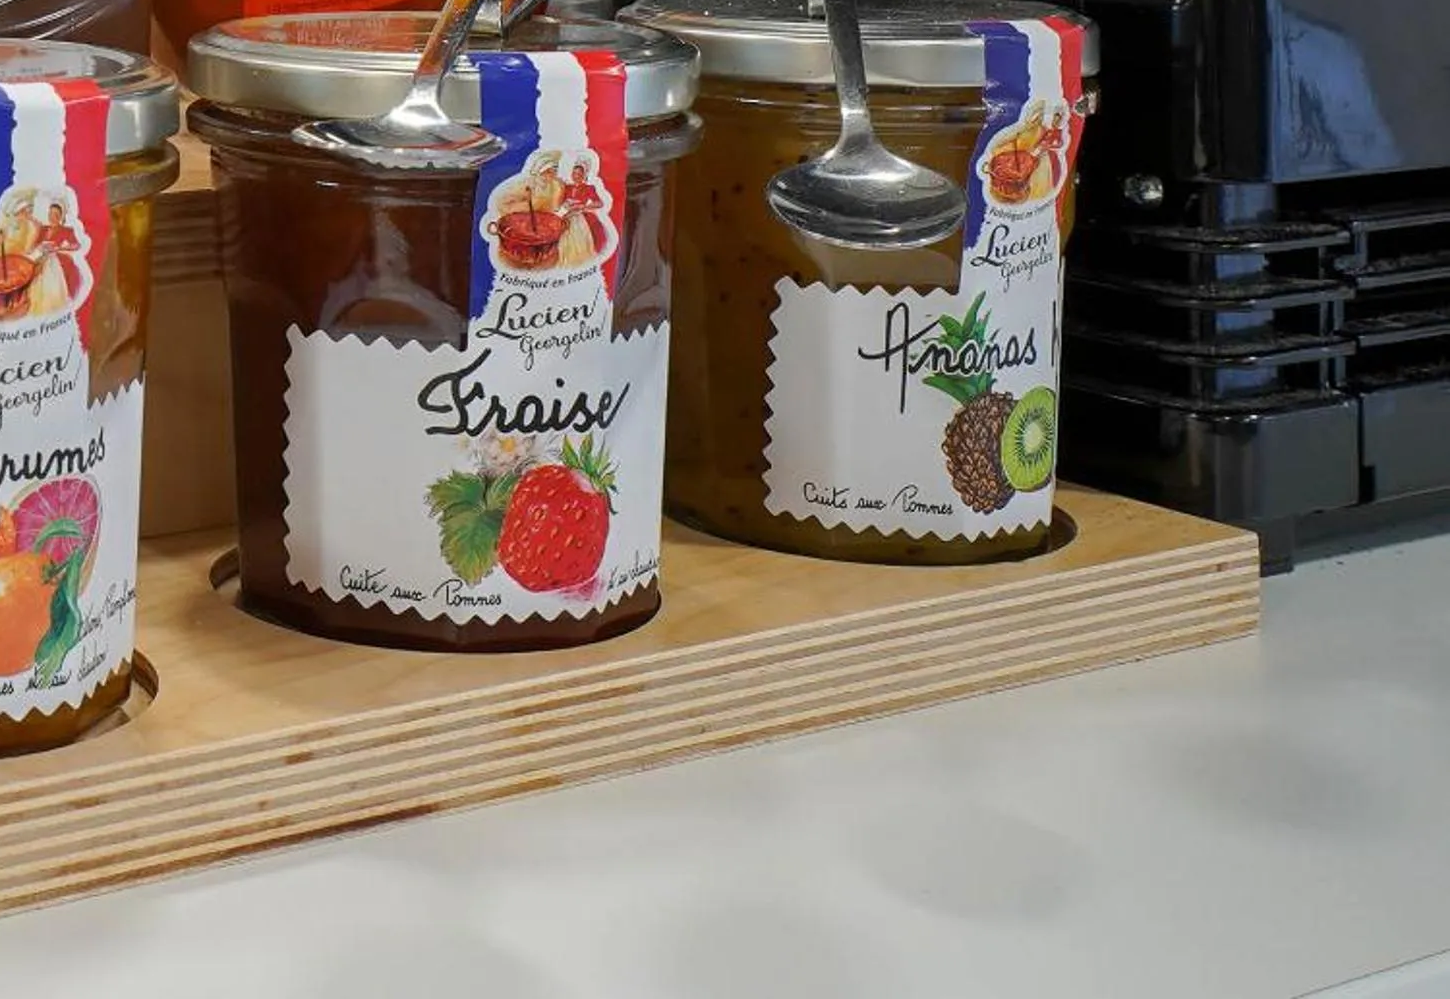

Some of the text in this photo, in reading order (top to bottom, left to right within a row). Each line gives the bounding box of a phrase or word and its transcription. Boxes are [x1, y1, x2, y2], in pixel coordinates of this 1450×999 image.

[970, 224, 1050, 267] Lucien
[551, 278, 565, 288] en
[22, 328, 37, 339] en
[476, 289, 600, 339] Lucien
[519, 315, 606, 371] Georgelin
[858, 301, 1039, 414] Ananas
[416, 348, 631, 436] Fraise
[854, 496, 887, 511] aux
[891, 484, 954, 515] Pommes
[390, 585, 427, 602] aux
[433, 578, 502, 607] Pommes
